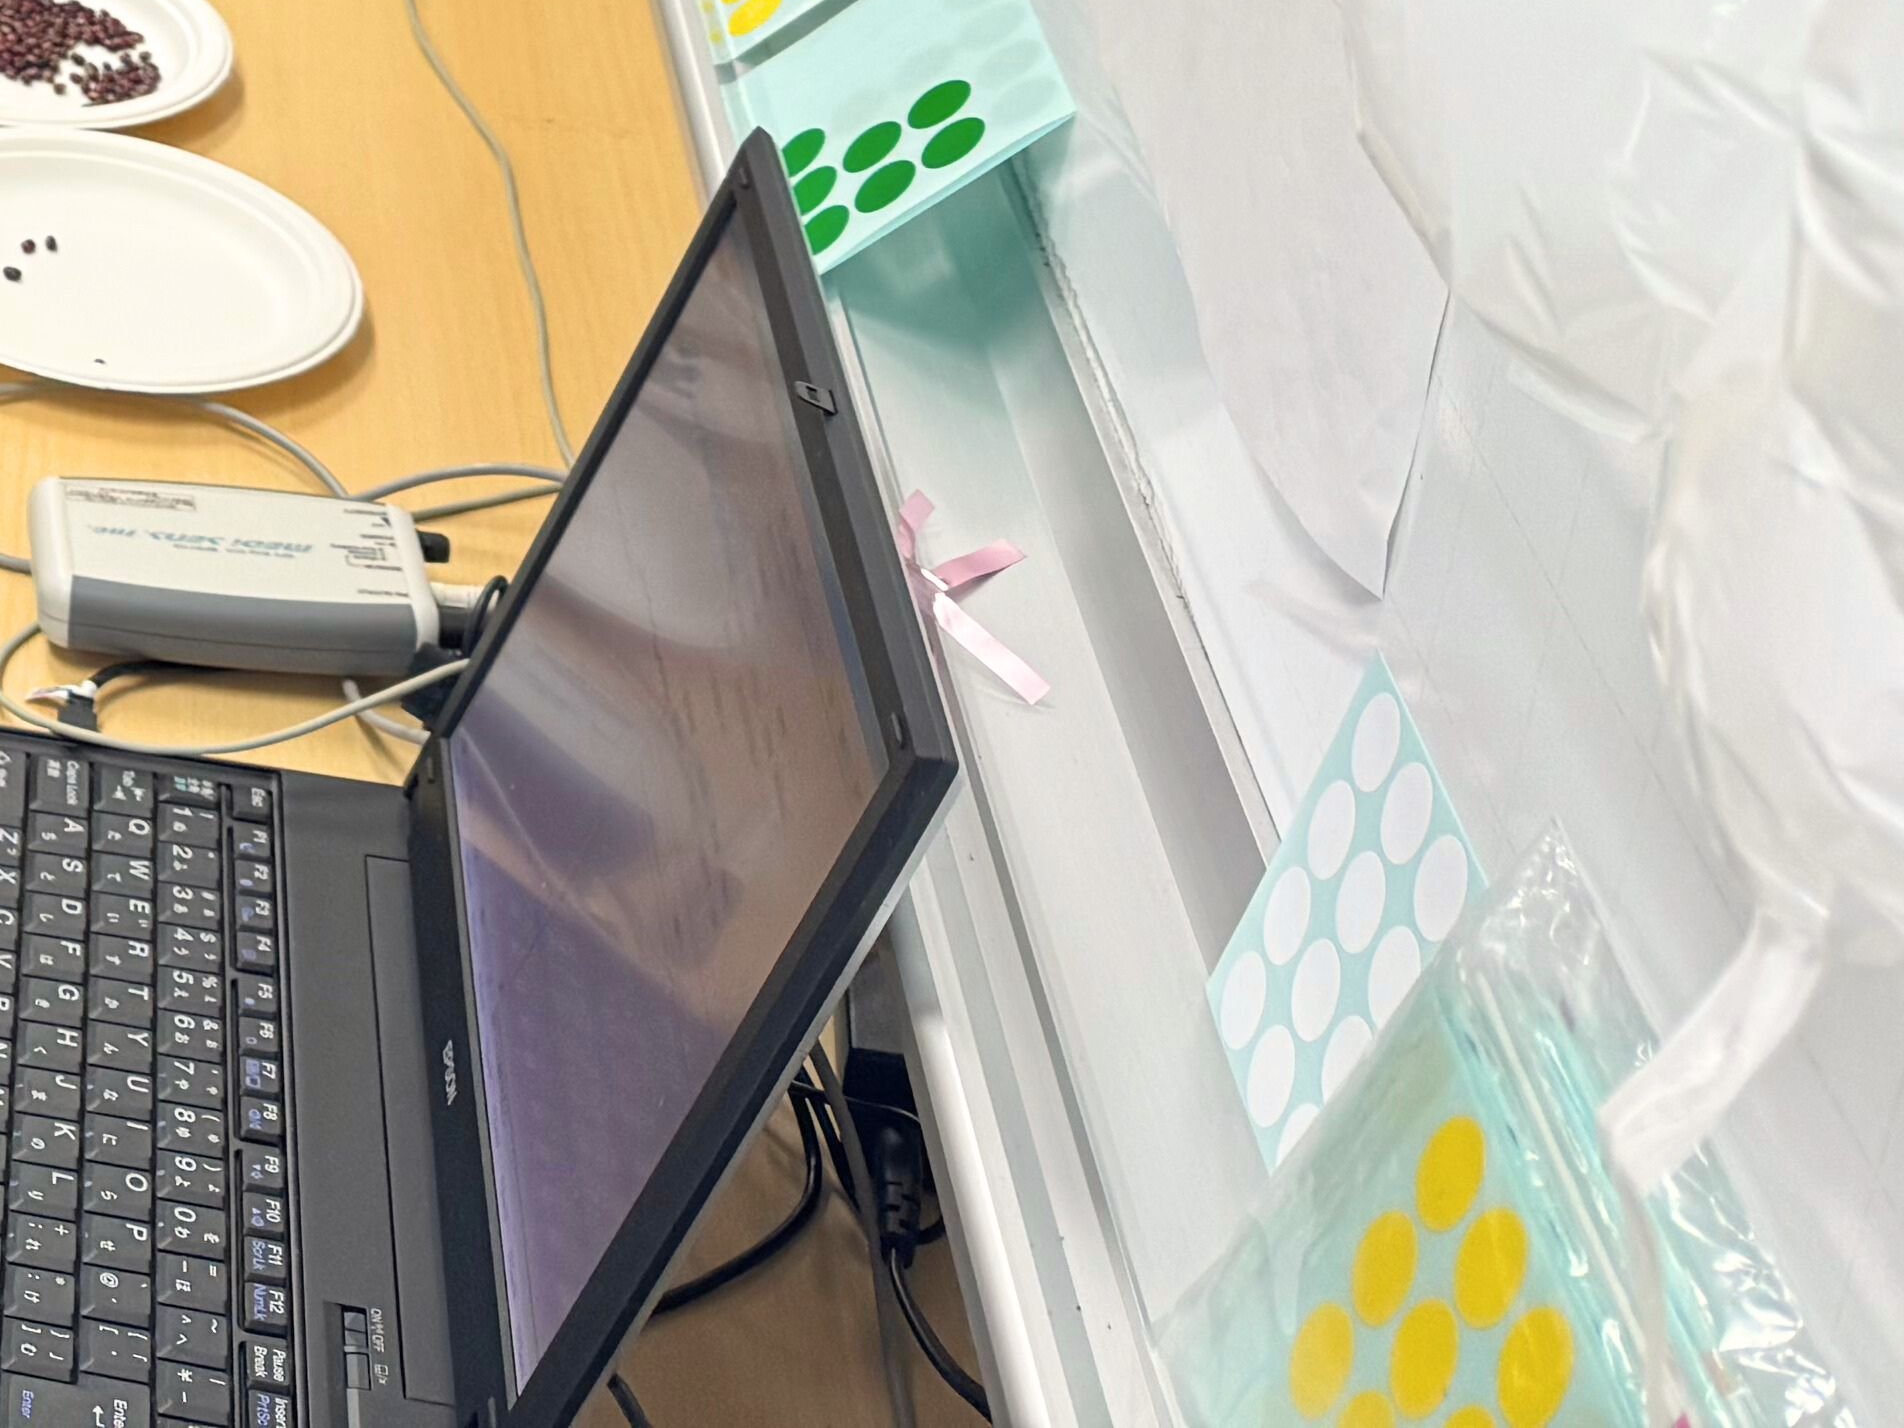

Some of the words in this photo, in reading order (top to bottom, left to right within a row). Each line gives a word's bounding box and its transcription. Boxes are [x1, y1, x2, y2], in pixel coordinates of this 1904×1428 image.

[173, 808, 191, 818] 1
[63, 818, 84, 833] A
[129, 819, 149, 835] Q
[173, 846, 191, 859] 2
[62, 858, 83, 872] S
[130, 861, 150, 880] W
[255, 864, 269, 880] F2
[174, 887, 191, 901] 3
[61, 898, 81, 914] D
[130, 899, 150, 914] E
[256, 901, 270, 916] F3
[173, 929, 192, 941] 4
[60, 940, 80, 956] F
[128, 941, 149, 957] R
[257, 936, 272, 952] F4
[173, 971, 193, 986] 5
[58, 985, 79, 1001] G
[128, 986, 148, 1000] T
[258, 983, 273, 999] F5
[173, 1015, 195, 1028] 6
[56, 1029, 79, 1046] H
[259, 1022, 275, 1038] F6
[128, 1032, 149, 1047] Y
[173, 1063, 194, 1075] 7
[261, 1063, 276, 1079] F7
[55, 1076, 77, 1091] J
[127, 1076, 149, 1092] U
[173, 1107, 195, 1122] 8
[263, 1103, 278, 1120] F8
[54, 1123, 76, 1139] K
[173, 1156, 195, 1171] 9
[264, 1155, 279, 1173] F9
[52, 1172, 73, 1185] L
[125, 1173, 147, 1191] O
[174, 1207, 195, 1223] 0
[266, 1200, 281, 1223] F10
[126, 1223, 147, 1240] P
[268, 1244, 284, 1266] F11
[268, 1291, 285, 1314] F12
[254, 1346, 268, 1378] Break
[271, 1348, 287, 1383] Pause
[21, 1389, 34, 1418] Enter
